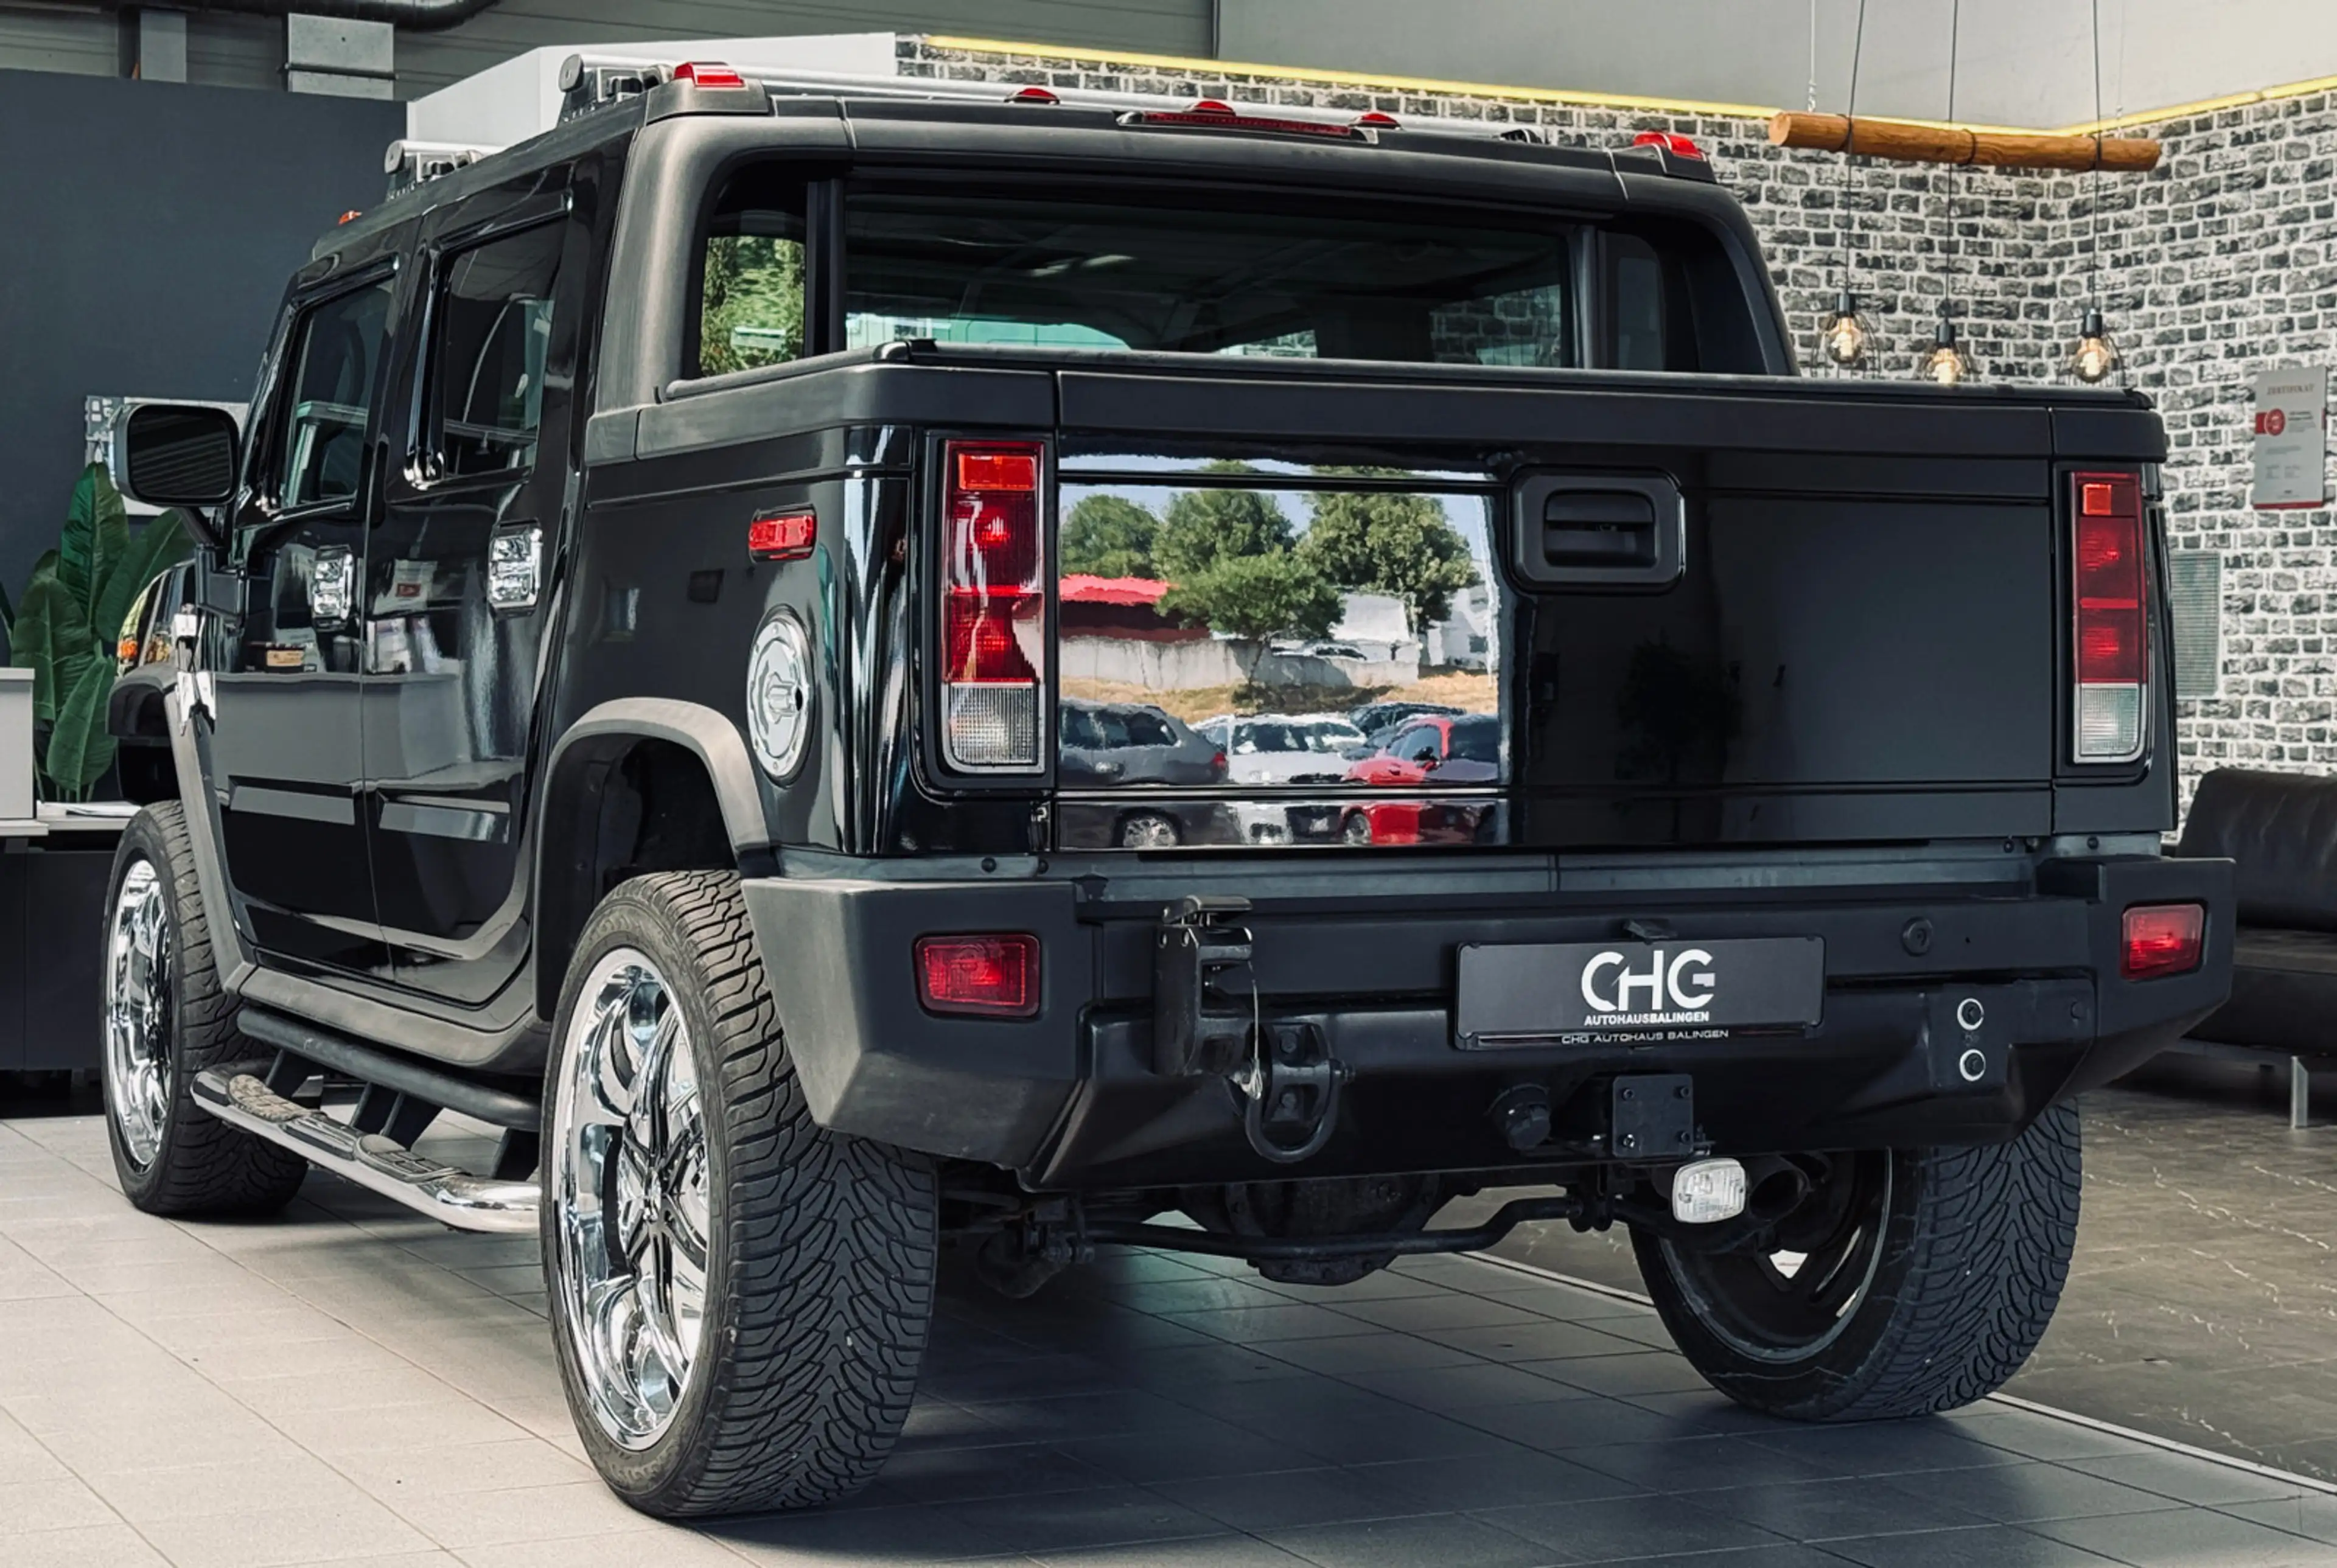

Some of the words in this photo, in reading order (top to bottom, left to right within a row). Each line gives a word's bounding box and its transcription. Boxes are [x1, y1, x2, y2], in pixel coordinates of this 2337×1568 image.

[1581, 949, 1716, 1012] CHG
[1561, 1034, 1589, 1045] CHG
[1593, 1031, 1663, 1043] AUTOHAUS
[1667, 1029, 1729, 1040] BALINGEN
